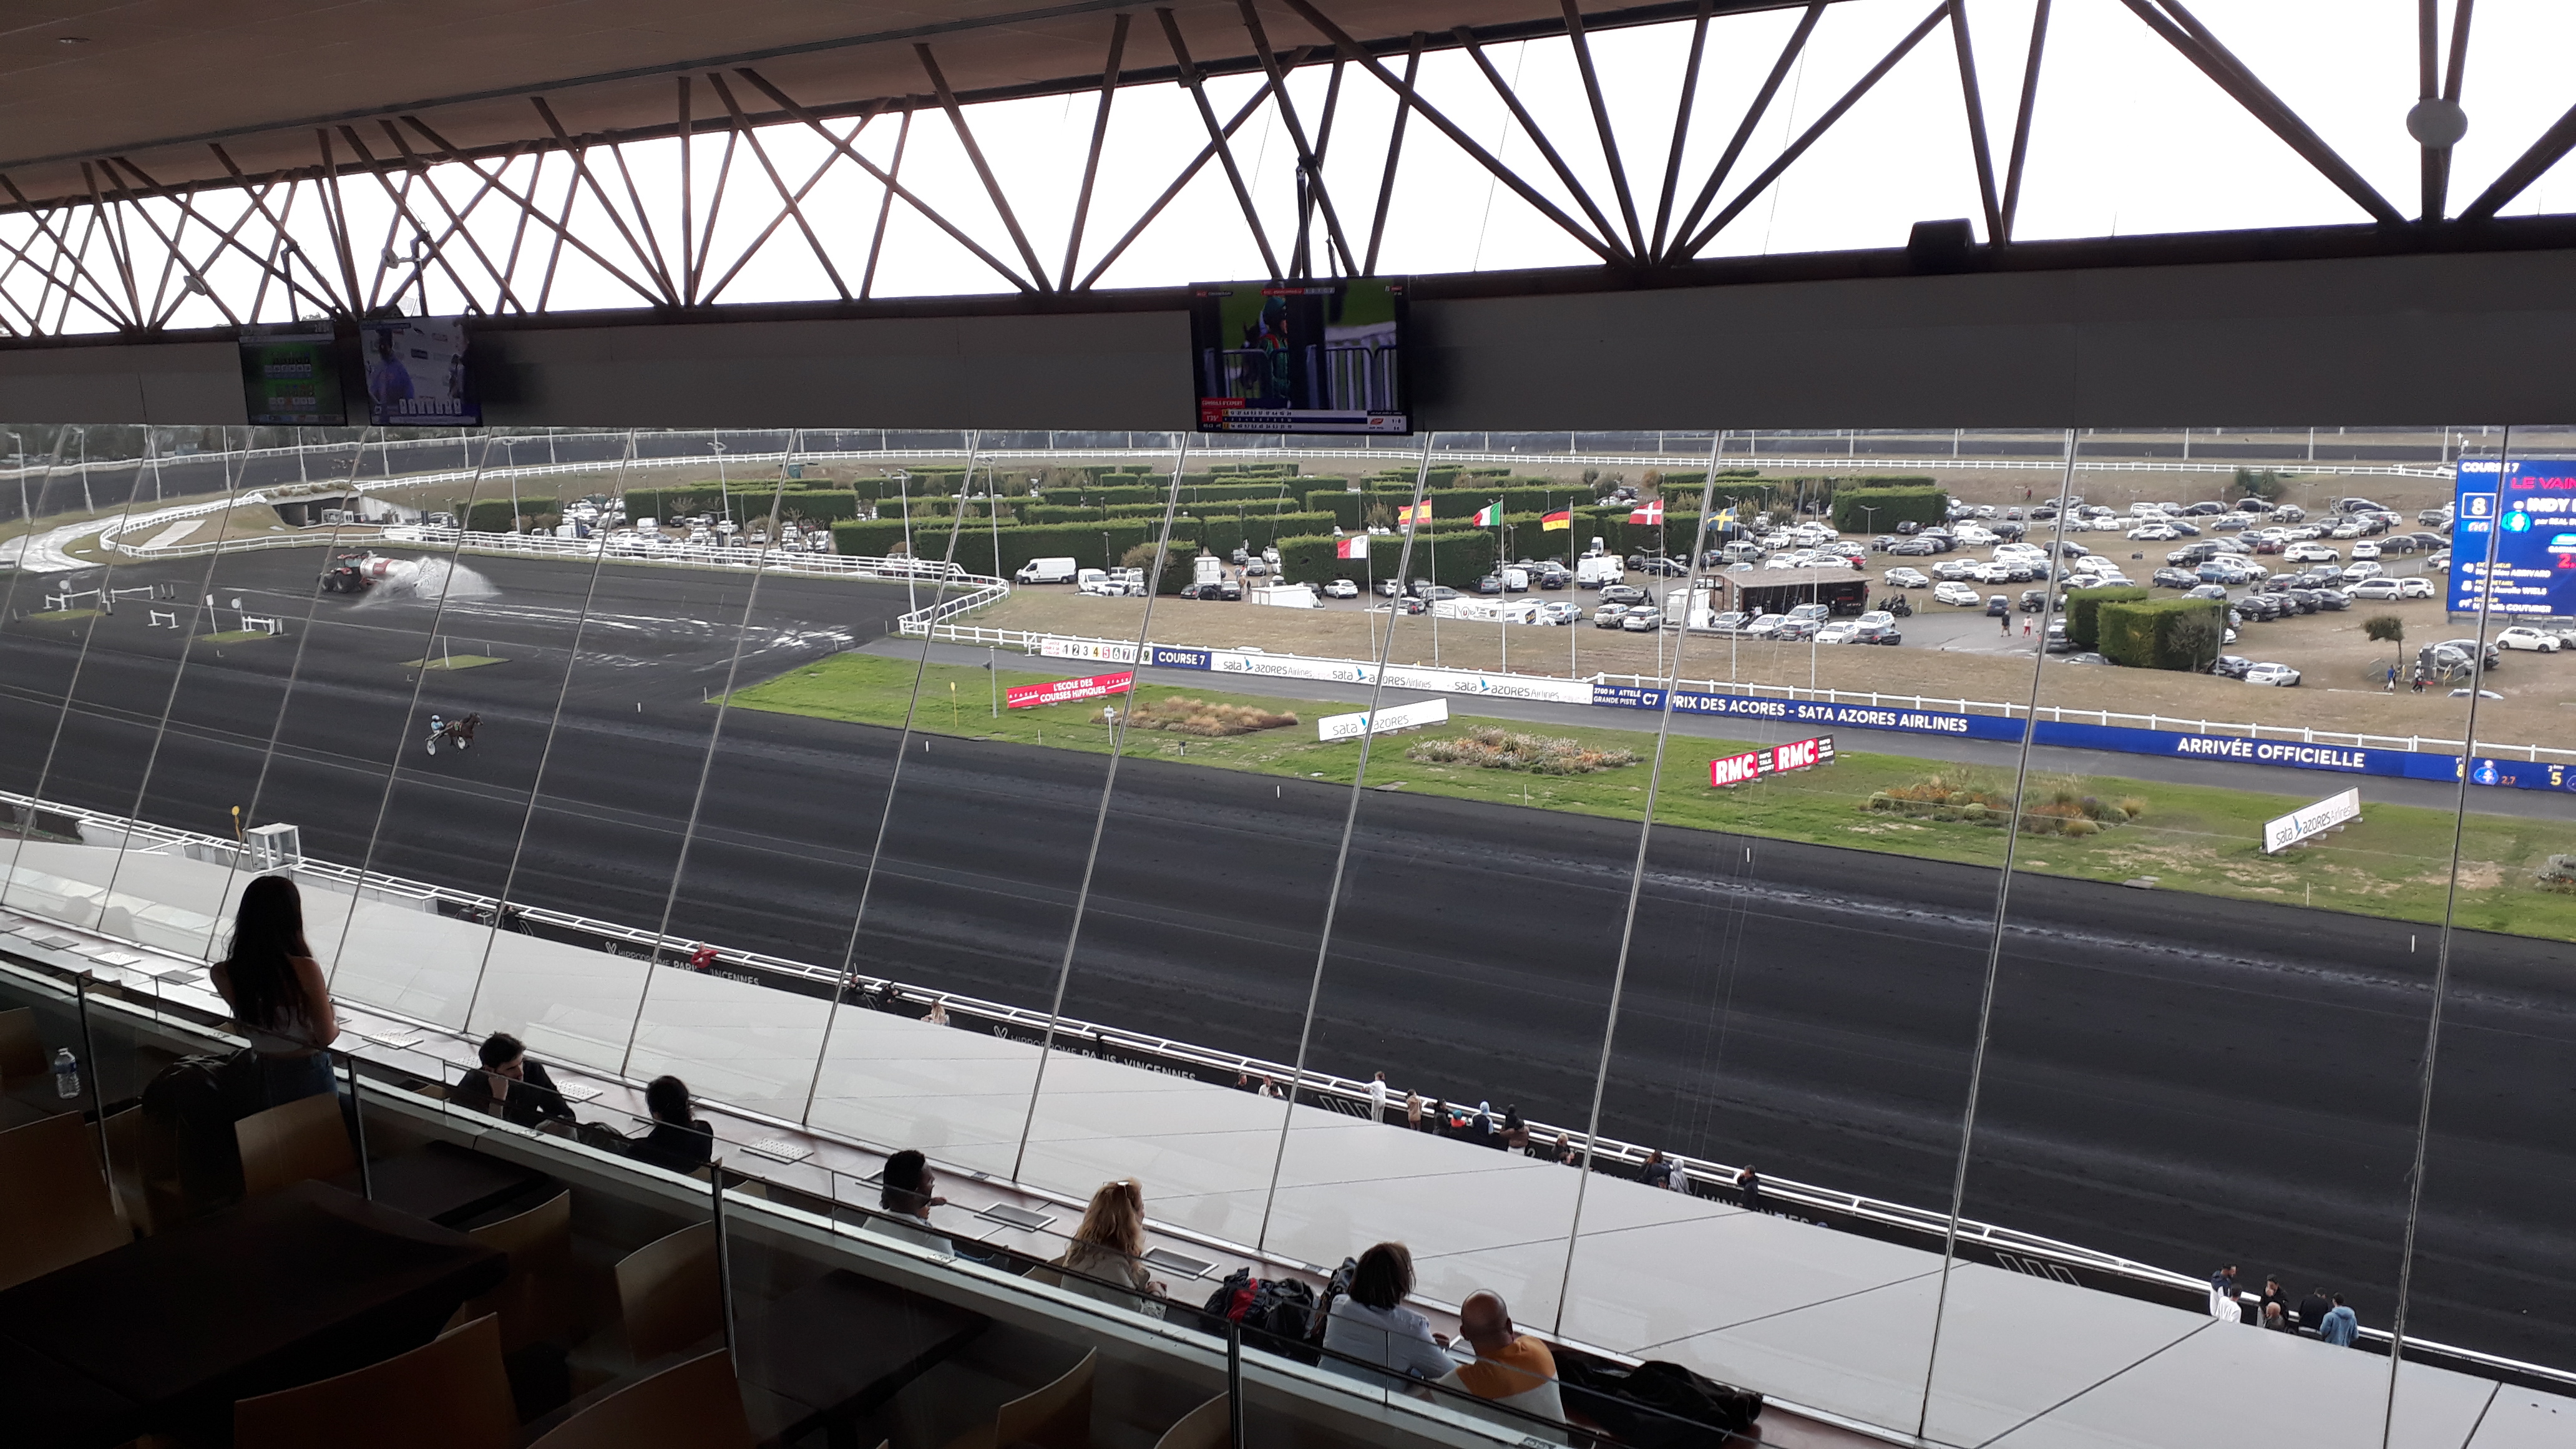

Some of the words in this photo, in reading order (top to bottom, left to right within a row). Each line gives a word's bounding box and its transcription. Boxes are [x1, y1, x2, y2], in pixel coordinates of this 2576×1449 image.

[2512, 462, 2520, 473] 7
[2511, 477, 2535, 489] LE
[2472, 497, 2486, 515] 8
[2527, 497, 2570, 512] INDY
[1073, 644, 1079, 656] 2
[1083, 646, 1088, 656] 3
[1093, 646, 1098, 657] 4
[1103, 647, 1110, 658] 5
[1113, 648, 1120, 659] 6
[1124, 649, 1130, 660] 7
[1143, 650, 1149, 661] 9
[1158, 651, 1198, 665] COURSE
[1199, 655, 1206, 666] 7
[1224, 660, 1242, 671] sata
[1288, 666, 1312, 676] Airlines
[1053, 680, 1078, 691] L'ECOLE
[1080, 679, 1093, 688] DES
[1332, 670, 1353, 681] sata
[1406, 678, 1432, 688] Airlines
[1040, 690, 1071, 702] COURSES
[1072, 686, 1106, 698] HIPPIQUES
[1455, 681, 1477, 691] sata
[1531, 688, 1559, 700] Airlines
[1619, 689, 1641, 698] ATTELÉ
[1594, 695, 1619, 704] GRANDE
[1642, 693, 1659, 706] C7
[1700, 697, 1726, 711] DES
[1729, 700, 1785, 716] ACORES
[1798, 706, 1834, 720] SATA
[1838, 709, 1895, 726] AZORES
[1899, 713, 1968, 732] AIRLINES
[1333, 723, 1357, 735] sata
[1778, 740, 1815, 769] RMC
[2177, 737, 2253, 758] ARRIVÉE
[2258, 744, 2365, 768] OFFICIELLE
[1717, 754, 1754, 784] RMC
[2456, 764, 2464, 778] 8
[2550, 772, 2562, 786] 5
[2276, 826, 2293, 846] sata
[673, 960, 698, 972] PARI
